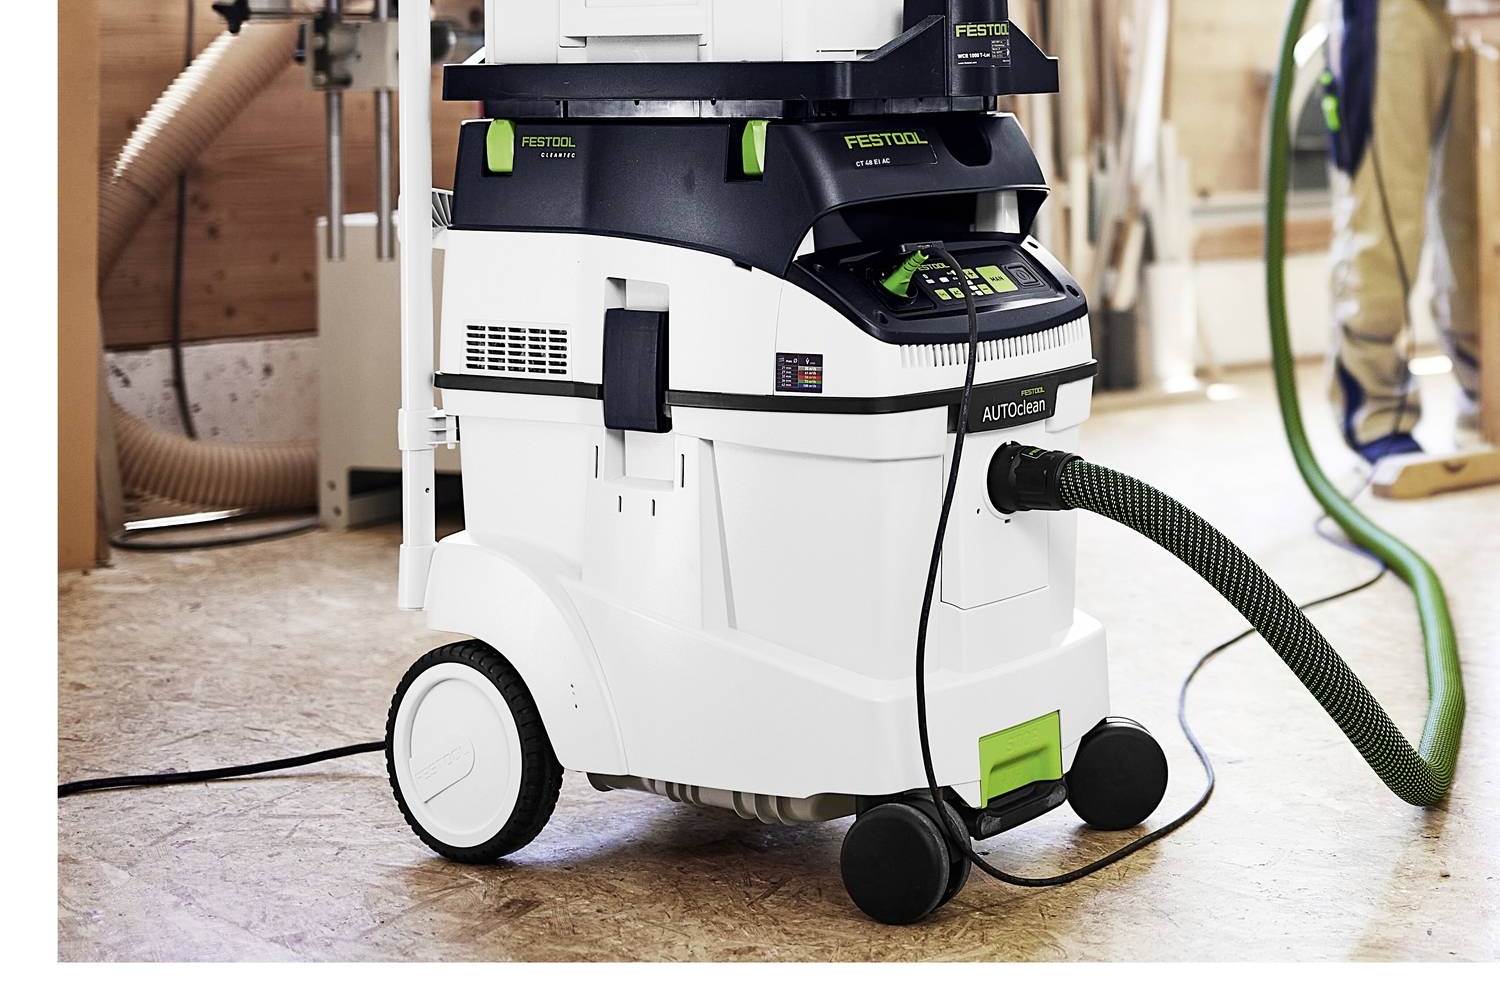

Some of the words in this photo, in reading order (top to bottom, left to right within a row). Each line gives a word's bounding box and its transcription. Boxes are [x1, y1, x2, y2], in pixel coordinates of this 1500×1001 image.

[521, 136, 576, 148] FESTOOL
[843, 131, 929, 149] FESTOOL
[882, 157, 891, 165] AC
[918, 262, 950, 271] ESTOOL
[1020, 386, 1046, 397] FESTOOL
[982, 399, 1046, 423] AUTOclean
